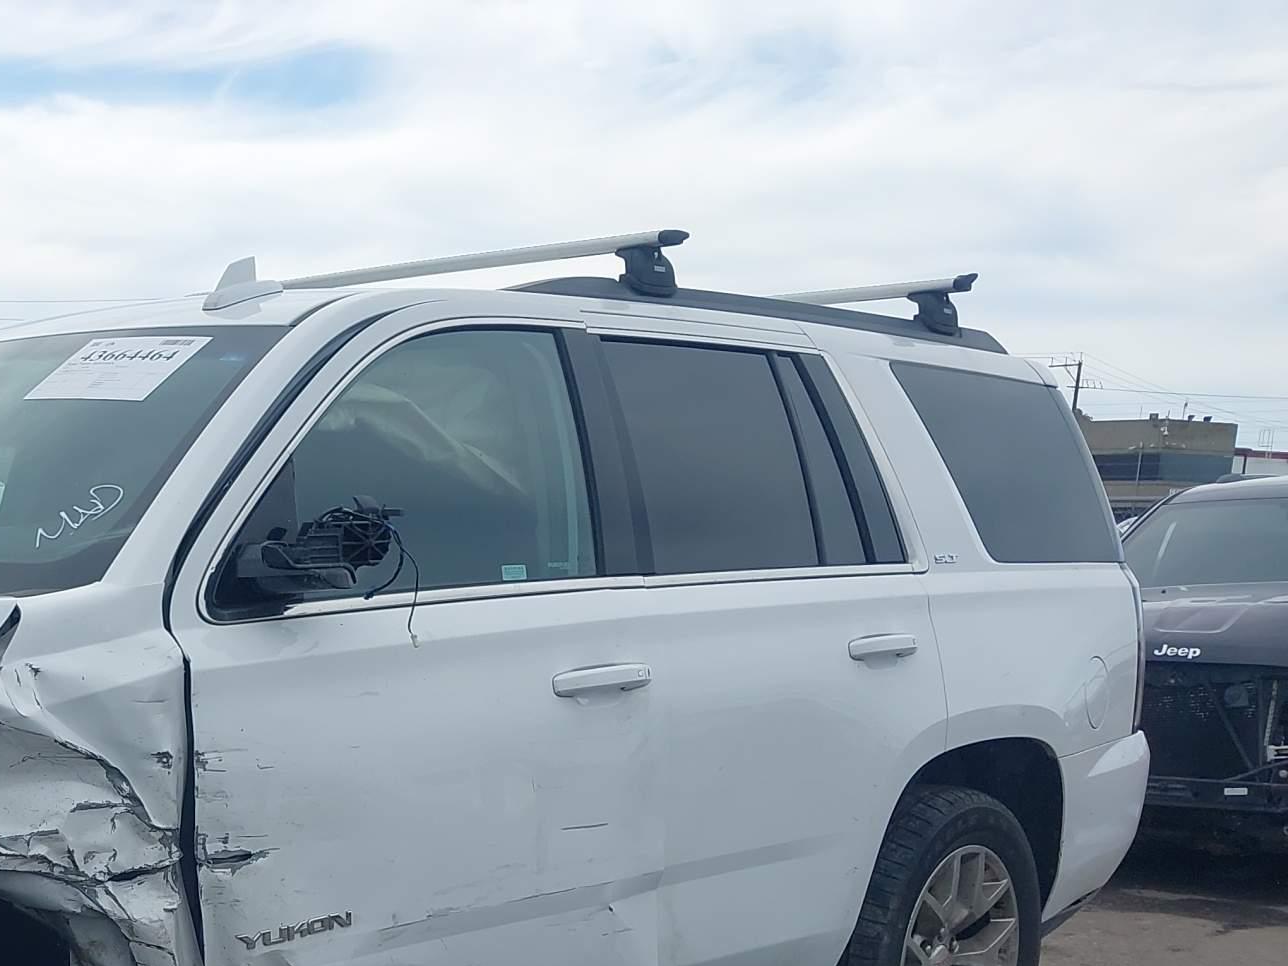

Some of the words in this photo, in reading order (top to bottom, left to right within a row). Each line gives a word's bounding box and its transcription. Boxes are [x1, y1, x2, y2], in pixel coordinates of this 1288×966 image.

[81, 350, 179, 362] 43664464
[1153, 643, 1201, 660] Jeep
[234, 910, 352, 951] YUKON
